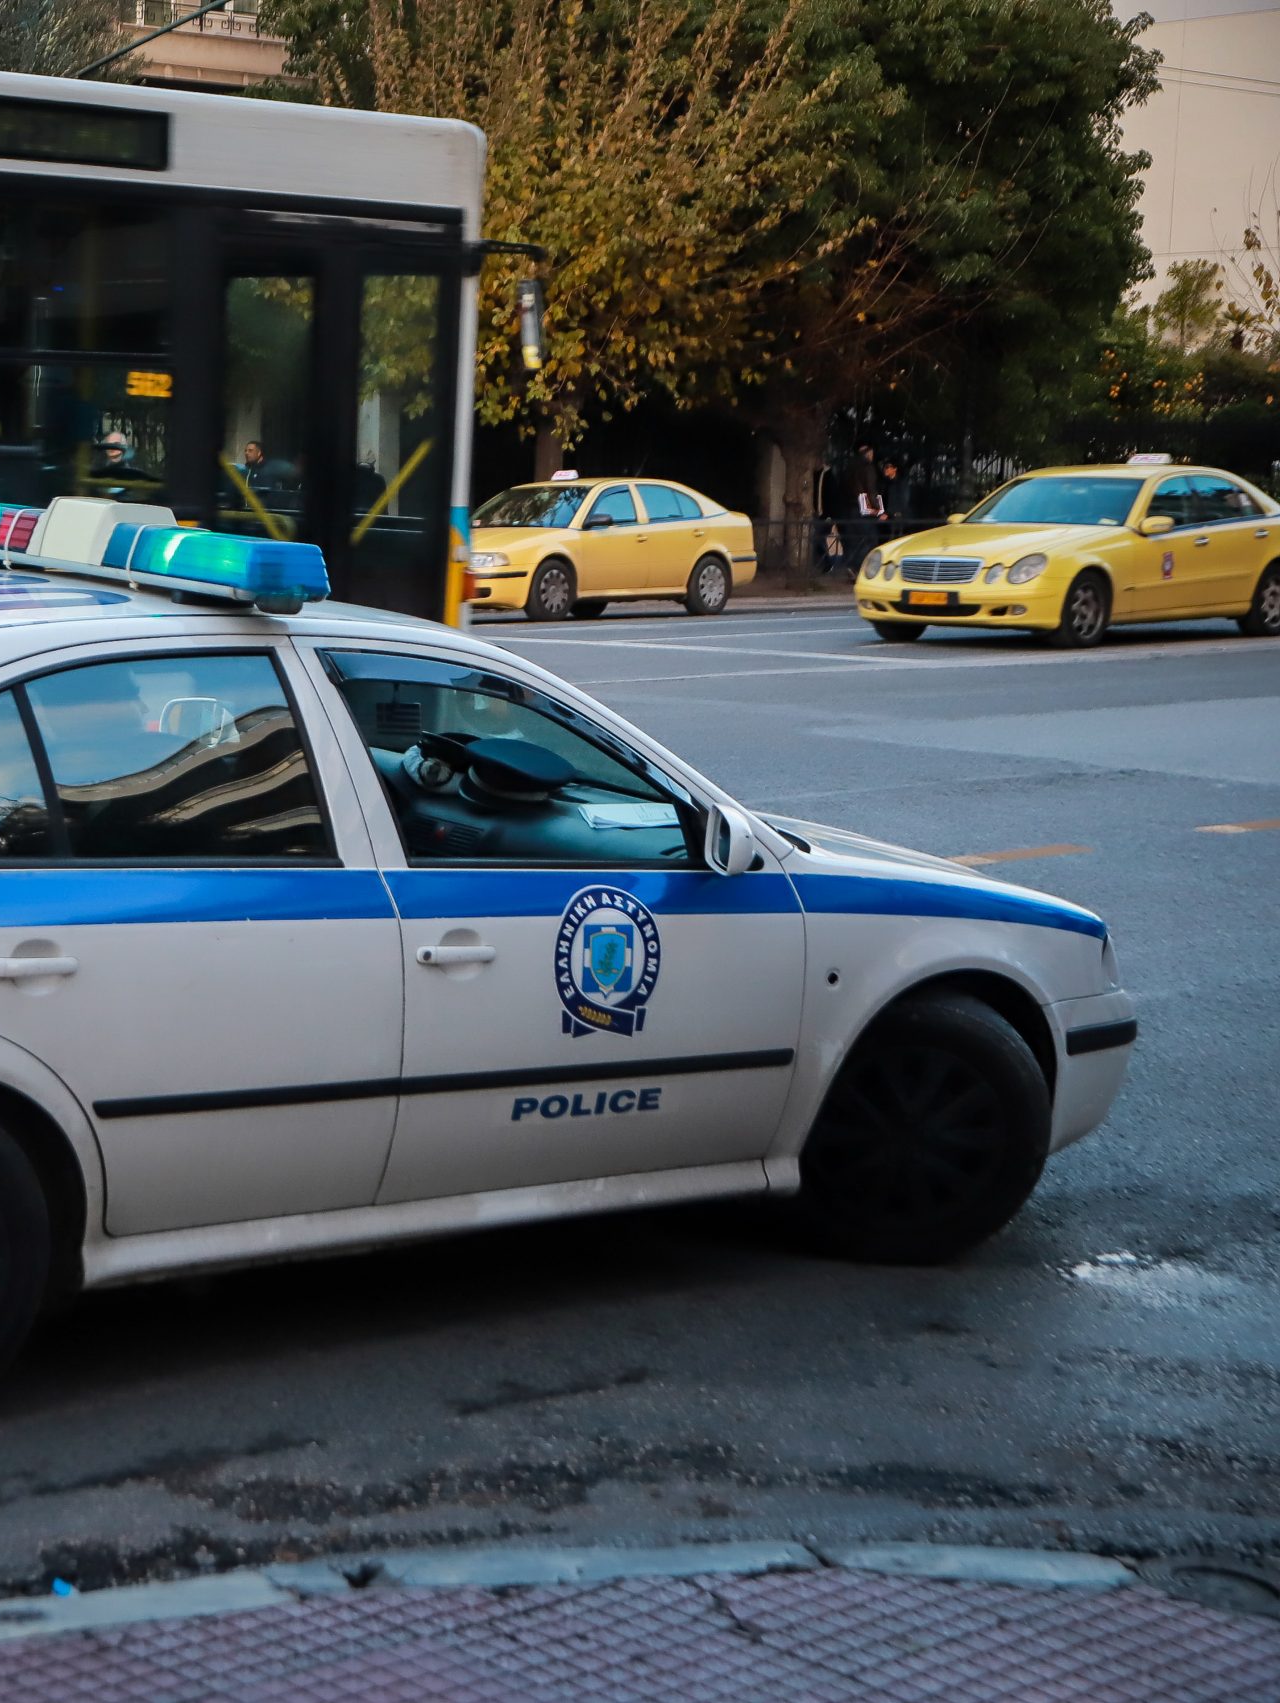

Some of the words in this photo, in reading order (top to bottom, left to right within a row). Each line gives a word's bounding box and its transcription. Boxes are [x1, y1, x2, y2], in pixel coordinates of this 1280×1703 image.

[558, 894, 598, 999] ΕΛΛΗΝΙΚΗ
[601, 892, 659, 996] ΑΣΤΥΝΟΜΙΑ
[511, 1087, 662, 1121] POLICE
